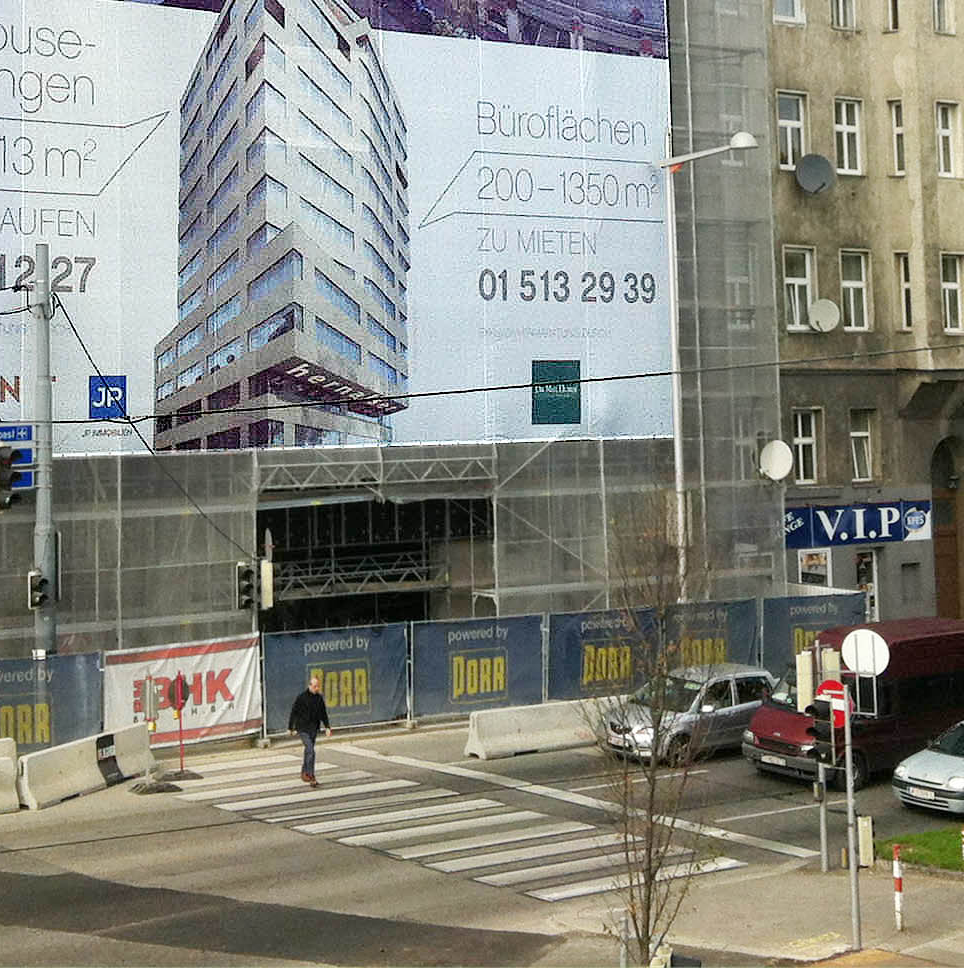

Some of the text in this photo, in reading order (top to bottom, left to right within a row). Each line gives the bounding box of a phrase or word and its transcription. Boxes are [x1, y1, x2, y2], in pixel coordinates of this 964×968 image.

[476, 100, 648, 146] Büroflächen
[477, 227, 598, 256] ZU MIETEN
[50, 255, 97, 294] 27
[477, 268, 657, 304] 01 513 29 39
[92, 386, 123, 408] JP
[816, 507, 902, 541] V.I.P
[303, 635, 370, 657] powered by
[448, 625, 508, 645] powered by
[37, 666, 53, 683] by
